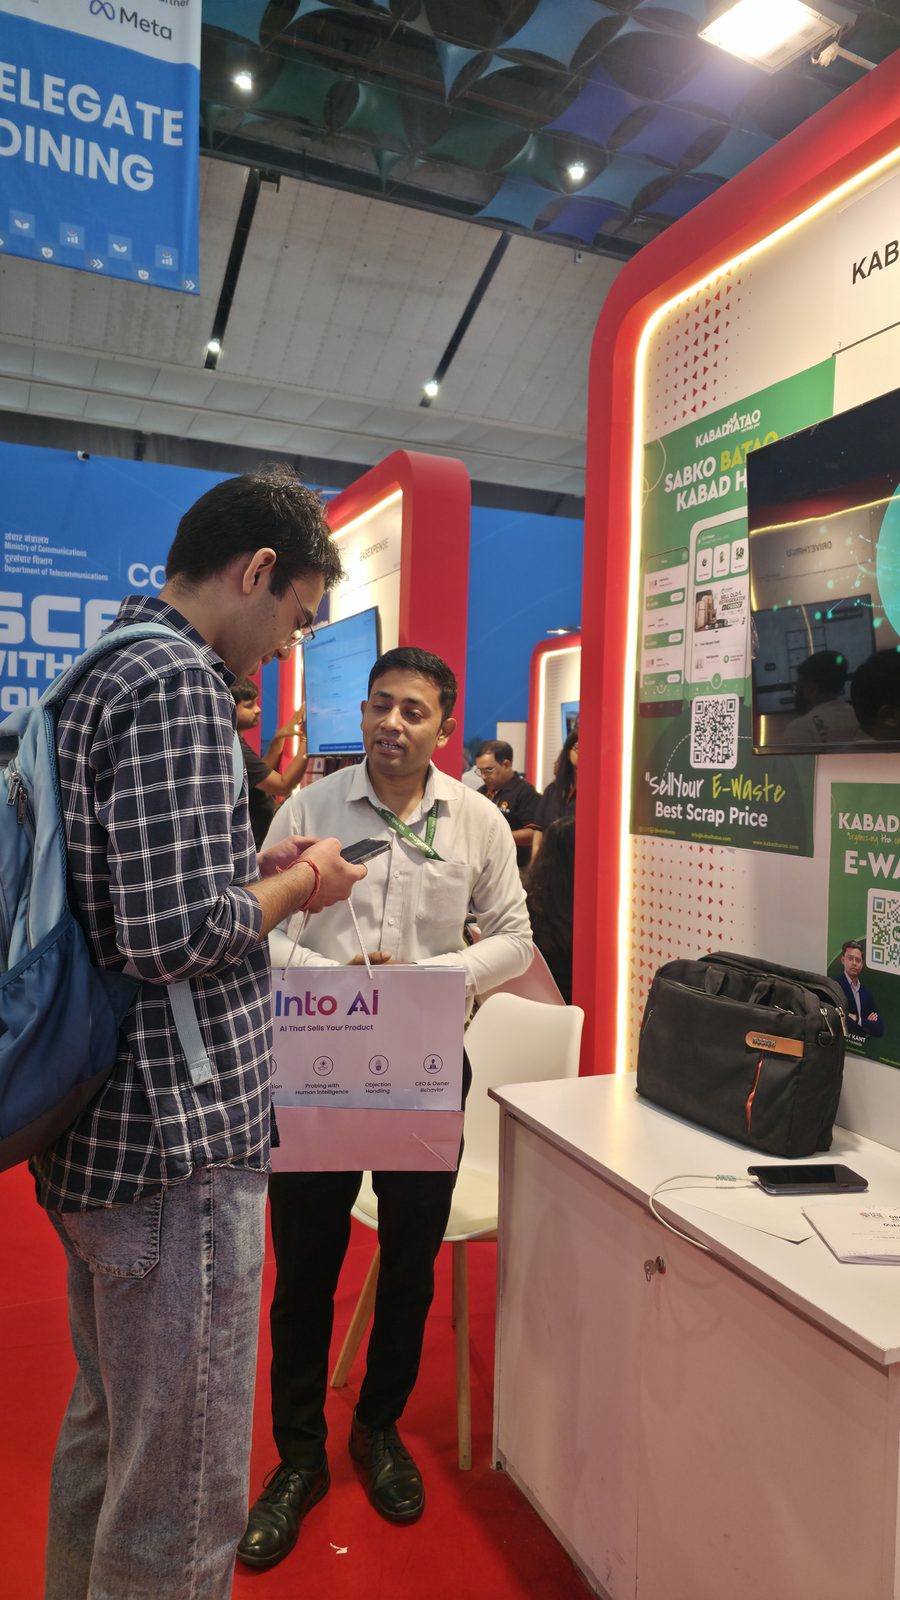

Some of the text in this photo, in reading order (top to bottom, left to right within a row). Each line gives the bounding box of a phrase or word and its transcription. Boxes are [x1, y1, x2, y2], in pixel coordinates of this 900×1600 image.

[119, 7, 173, 41] Meta
[852, 239, 900, 285] KAB
[664, 456, 717, 493] SABKO
[677, 475, 731, 512] KABAD
[4, 541, 87, 558] Ministry of Communications
[4, 564, 109, 581] Department of Telecommunications
[0, 650, 81, 679] ITH
[712, 773, 786, 803] E-Waste
[655, 801, 768, 827] Best Scrap Price
[838, 812, 900, 833] KABAD
[275, 990, 338, 1017] Into
